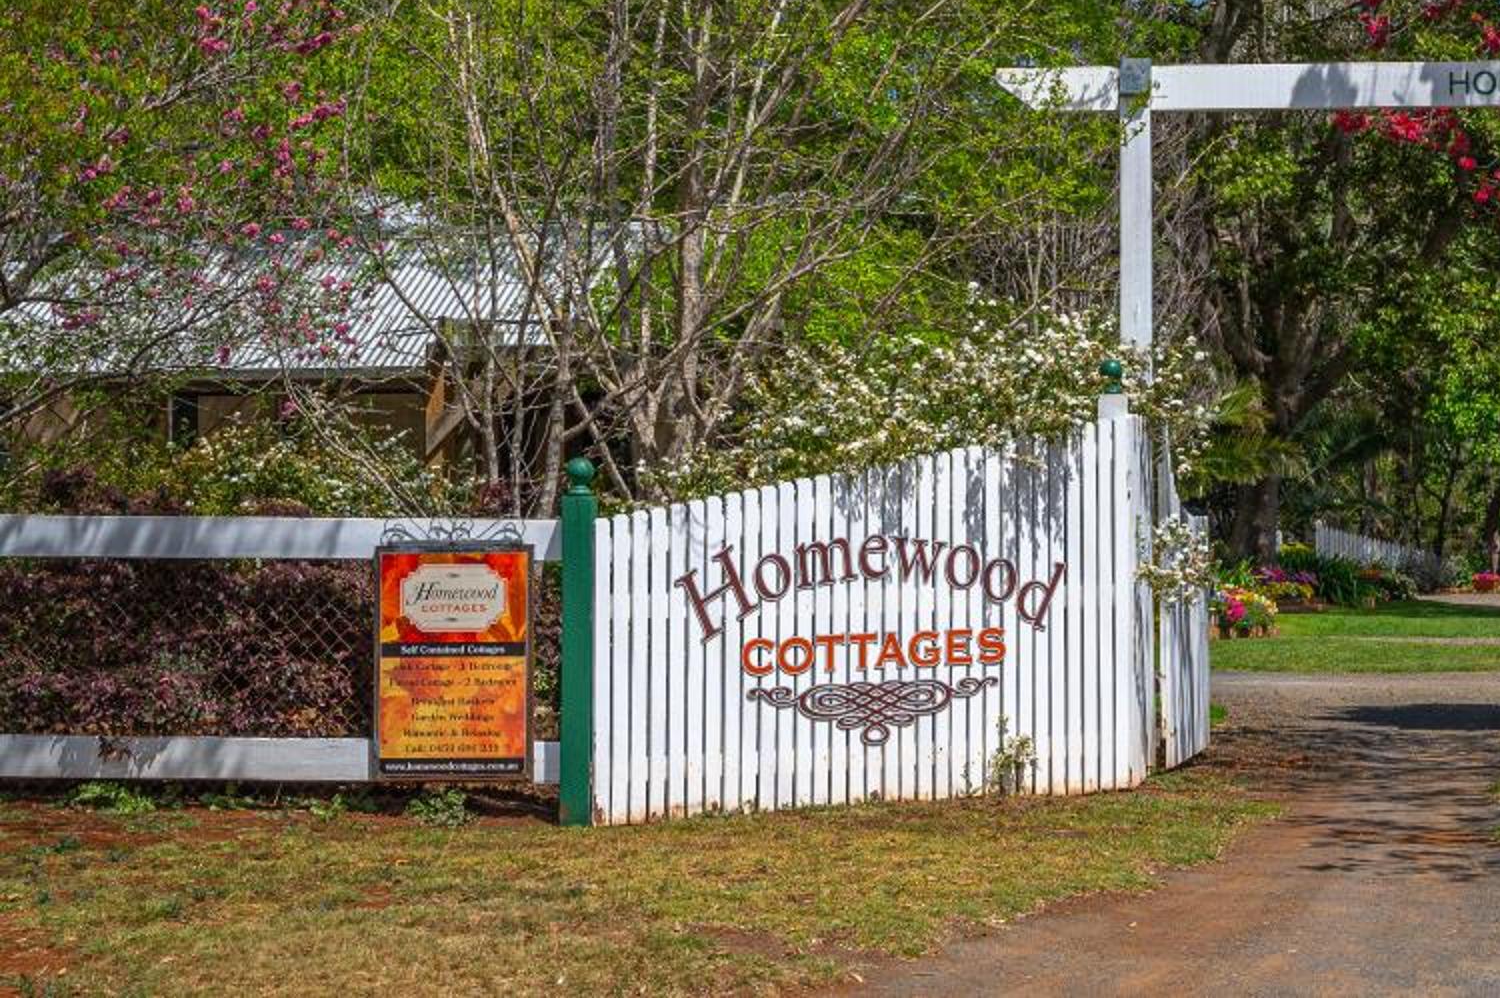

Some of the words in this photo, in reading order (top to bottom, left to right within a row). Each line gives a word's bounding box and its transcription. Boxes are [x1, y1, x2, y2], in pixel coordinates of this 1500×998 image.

[406, 581, 499, 606] Homewood
[674, 533, 1068, 646] Homewood
[421, 604, 488, 614] COTTAGES
[401, 644, 418, 654] Self
[740, 627, 1008, 678] COTTAGES
